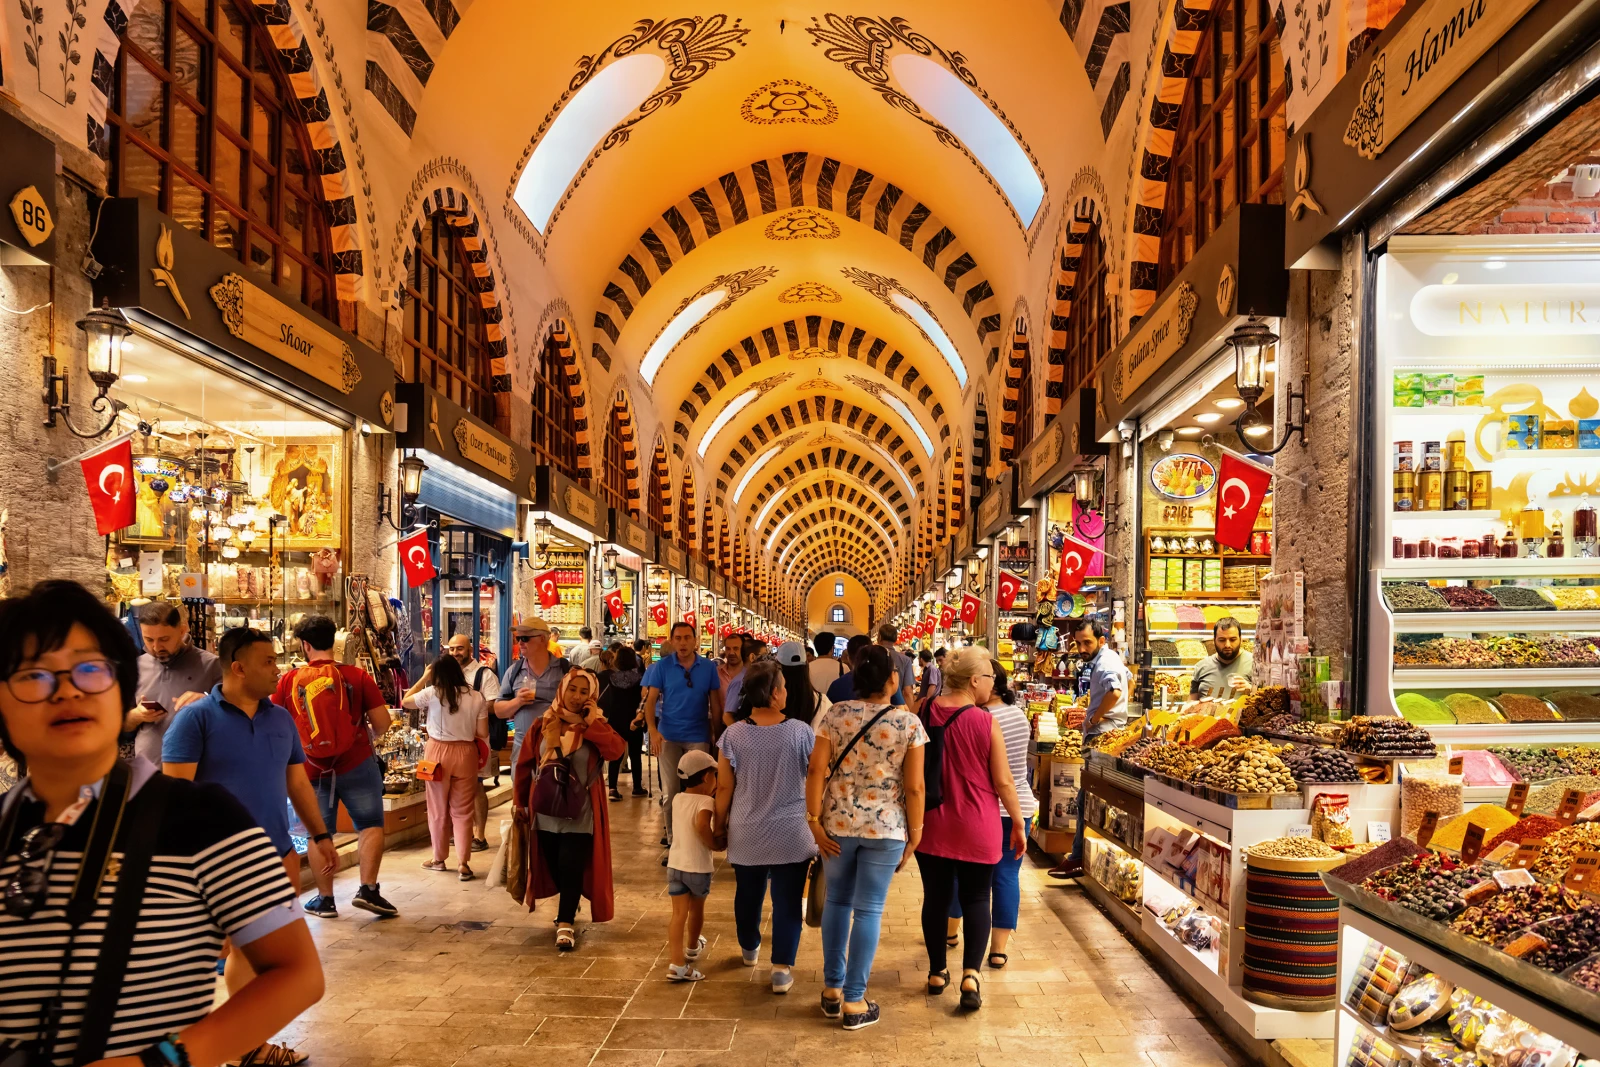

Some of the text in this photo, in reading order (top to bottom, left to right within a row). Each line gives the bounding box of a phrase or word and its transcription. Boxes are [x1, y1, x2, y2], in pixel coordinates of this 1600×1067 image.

[1401, 0, 1487, 96] Hama
[23, 199, 45, 232] 86
[1219, 276, 1229, 304] 77
[1459, 300, 1600, 324] NATUR
[280, 323, 314, 357] Shoar
[1128, 319, 1170, 379] Galata Spice
[384, 399, 392, 415] 84
[484, 442, 508, 466] Antiques
[1163, 505, 1194, 519] SPICE
